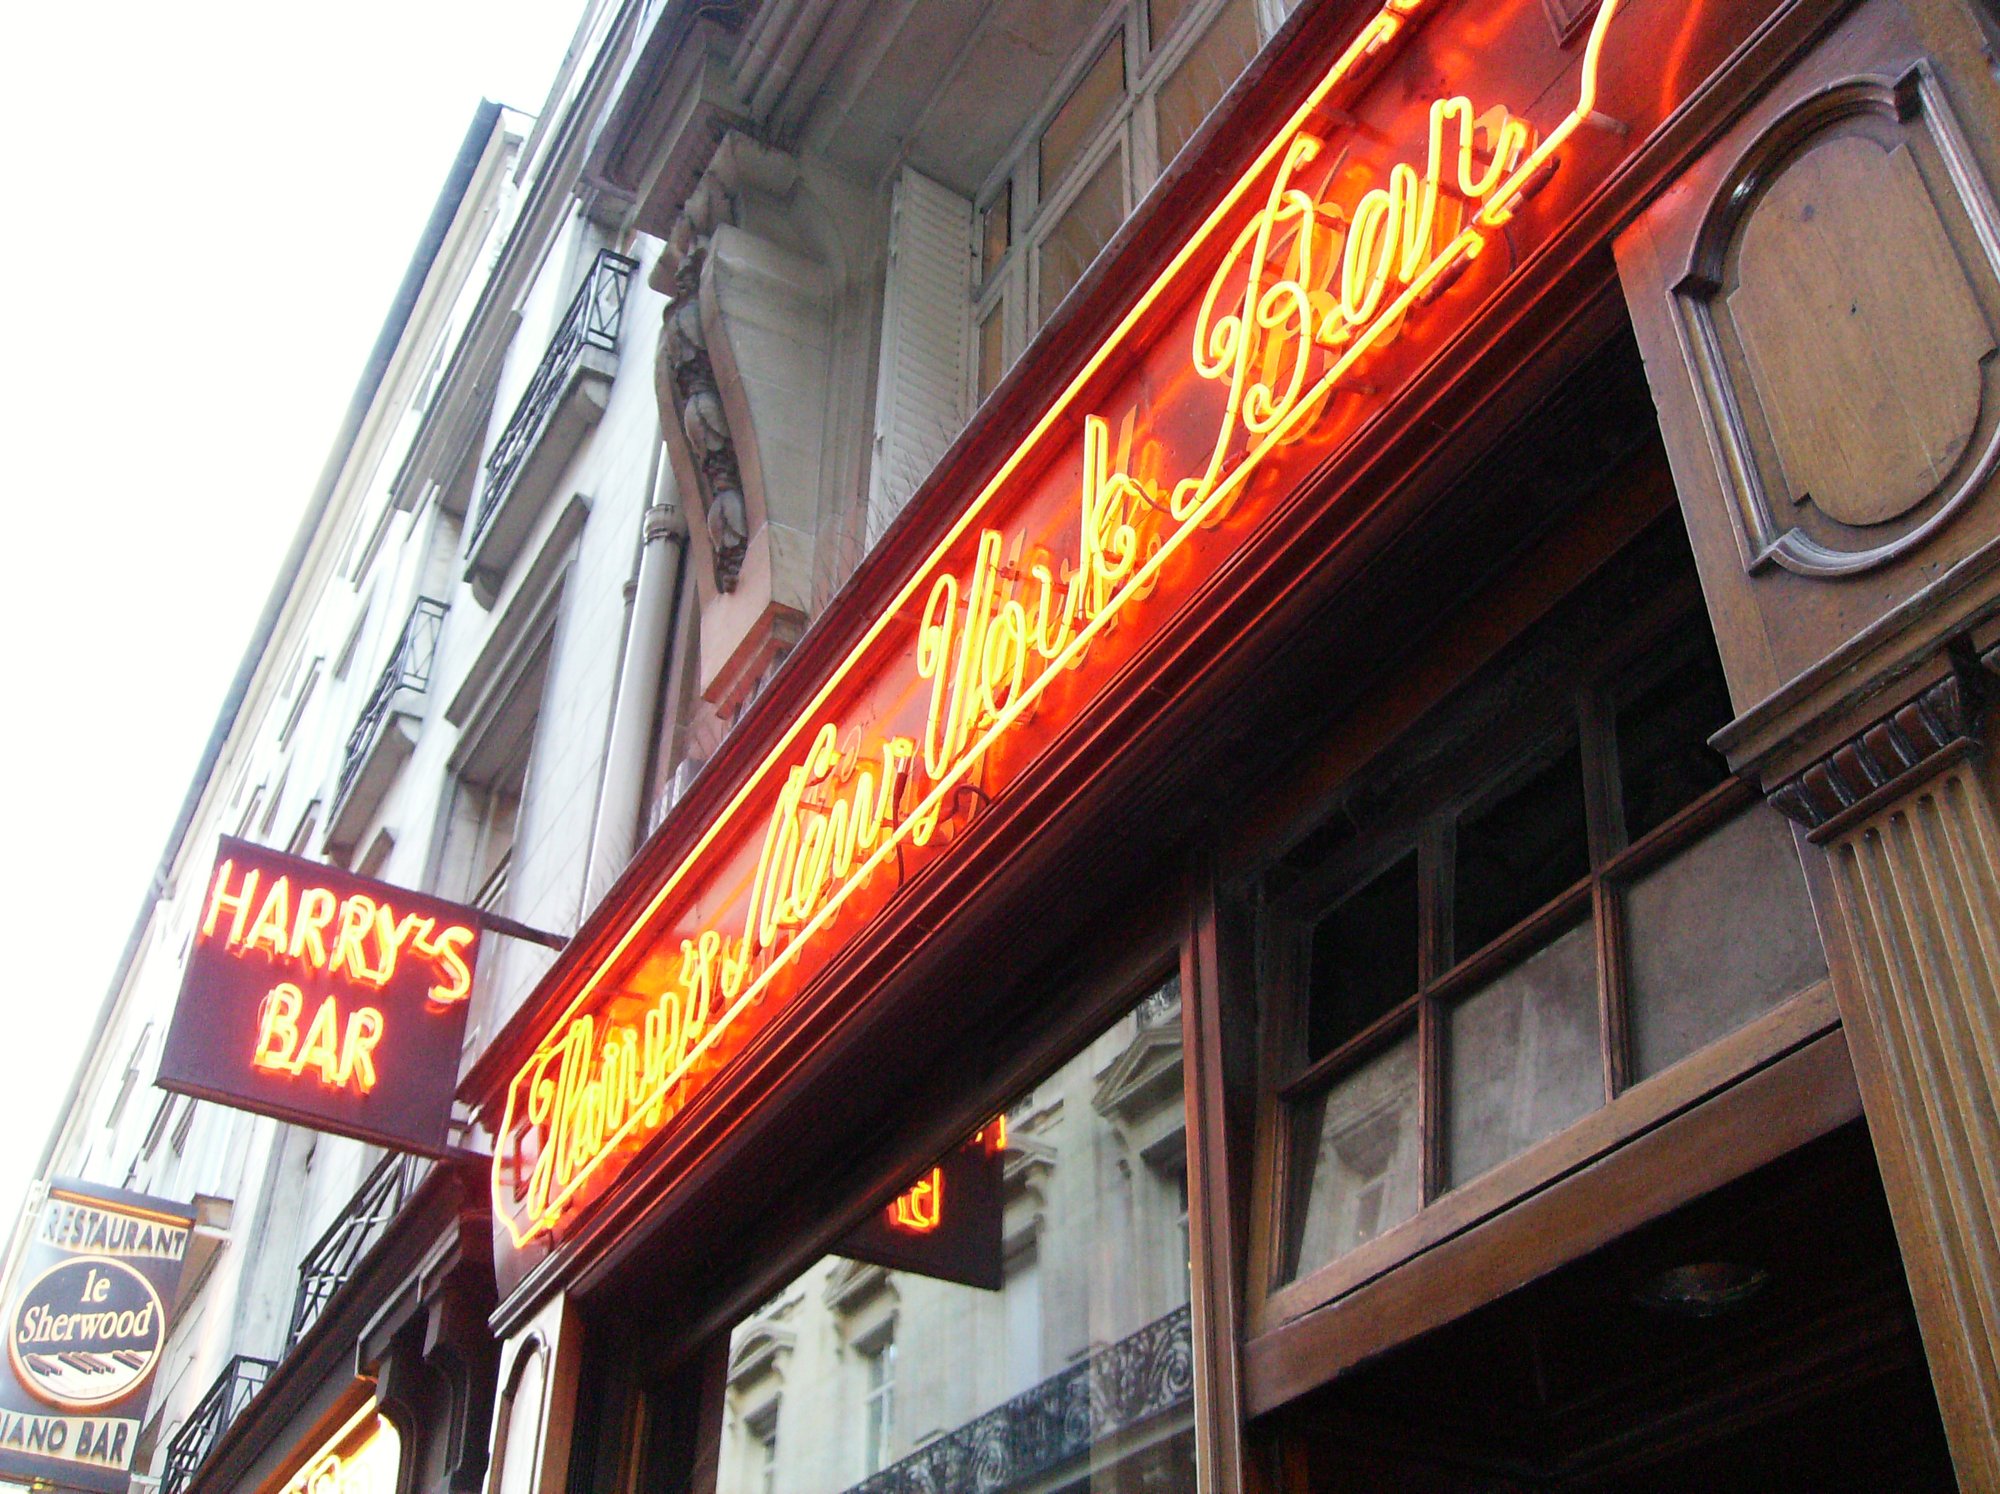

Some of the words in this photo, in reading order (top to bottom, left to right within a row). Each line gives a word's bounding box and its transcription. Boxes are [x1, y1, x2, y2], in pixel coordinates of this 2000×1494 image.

[527, 929, 721, 1221] Harry's
[720, 722, 914, 998] New
[914, 413, 1138, 847] York
[1171, 95, 1528, 523] Bar
[200, 858, 476, 1006] HARRY'S
[252, 982, 386, 1096] BAR
[42, 1206, 188, 1255] RESTAURANT
[81, 1268, 112, 1302] le
[18, 1301, 154, 1344] Sherwood
[0, 1411, 69, 1451] IANO
[75, 1420, 129, 1463] BAR
